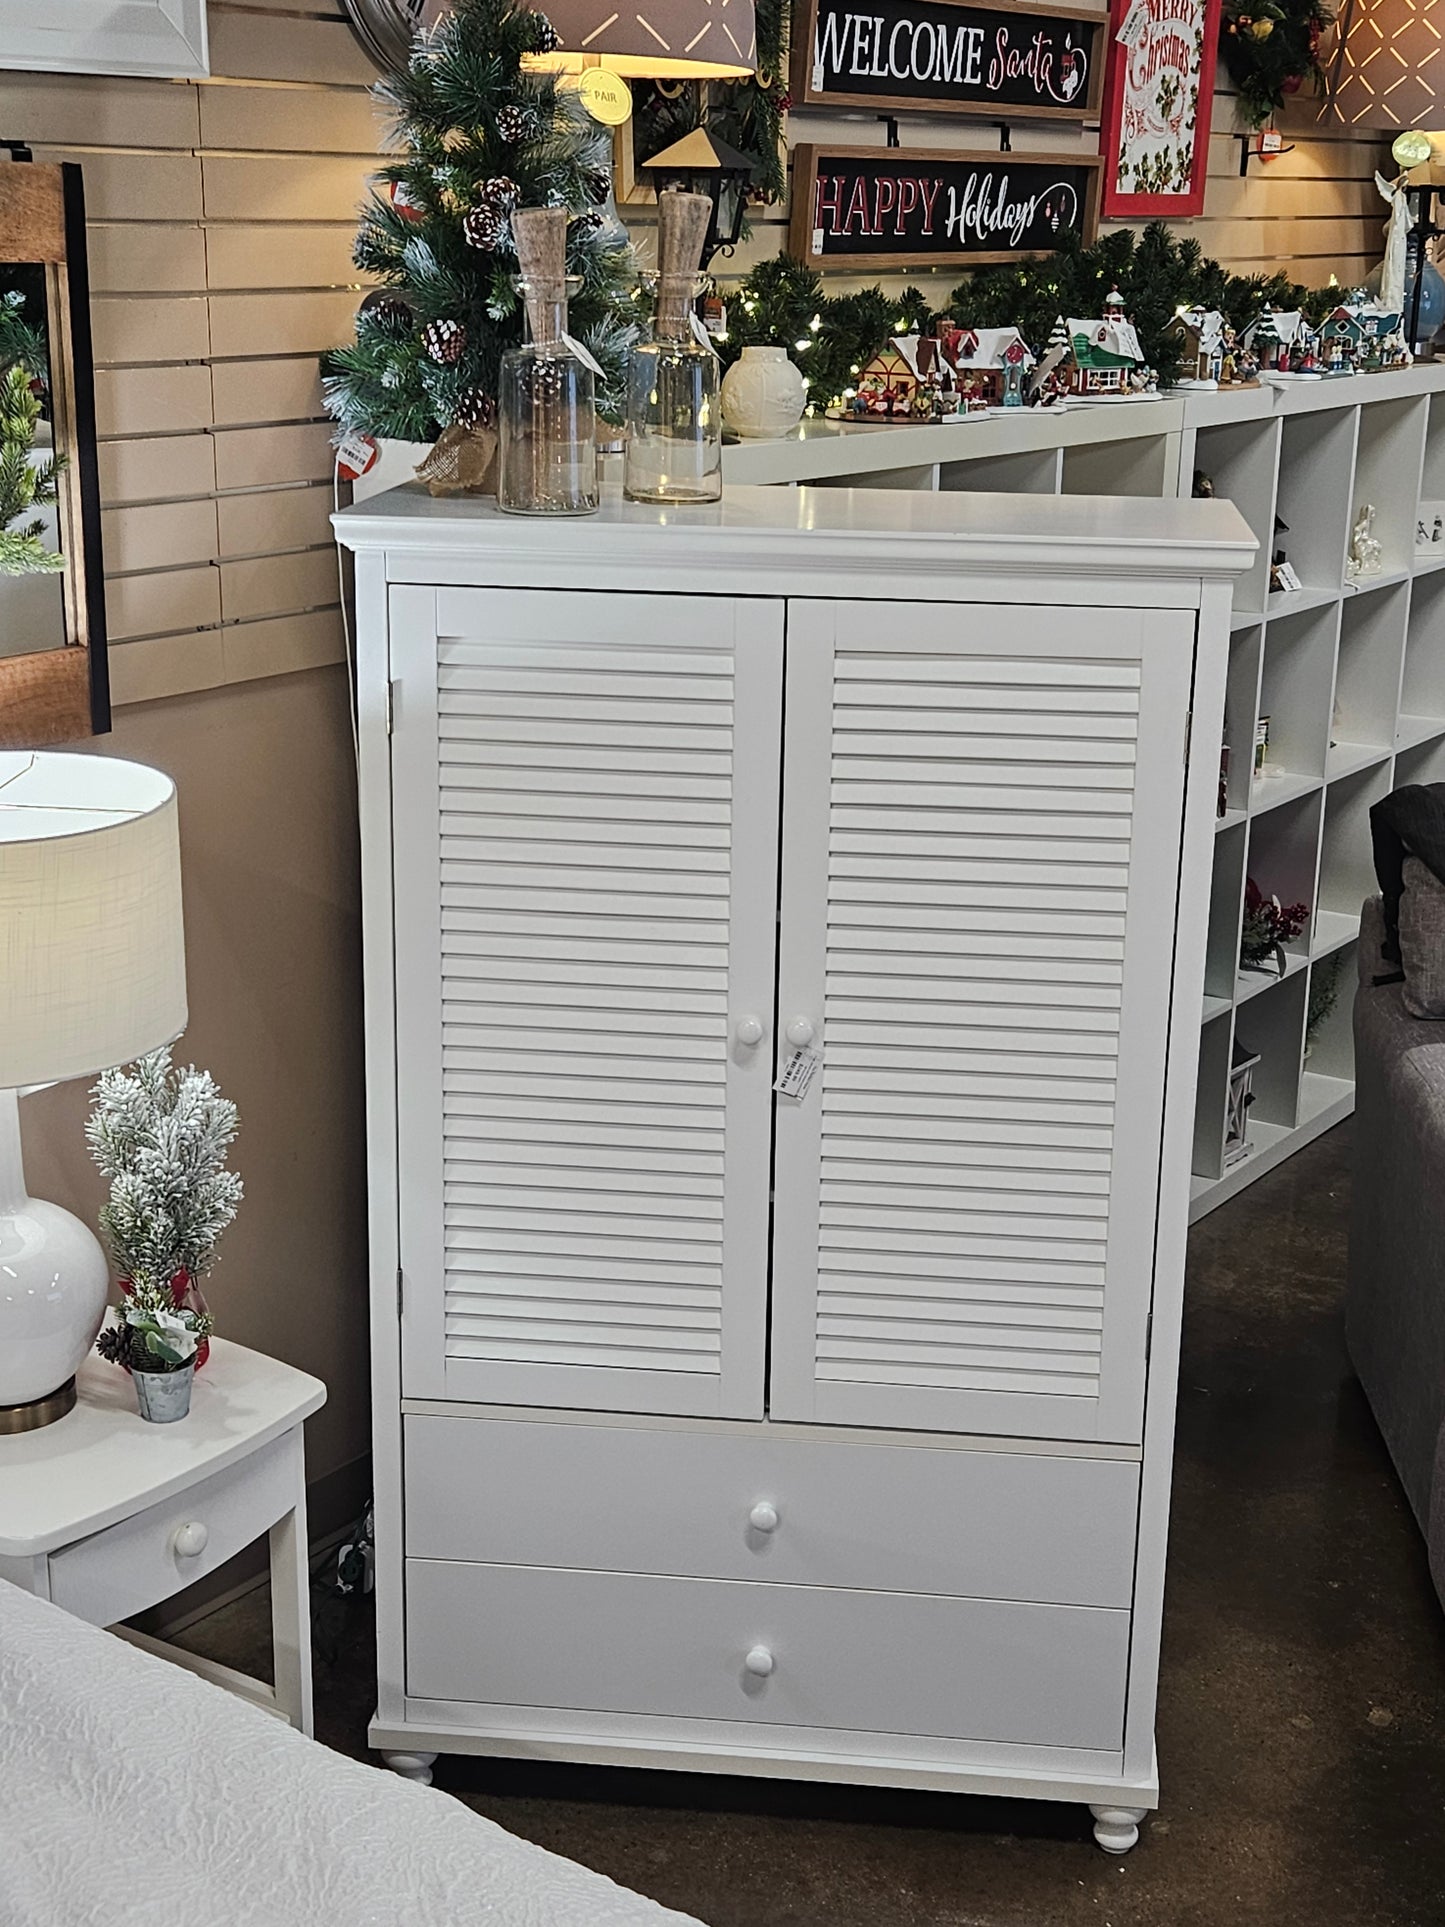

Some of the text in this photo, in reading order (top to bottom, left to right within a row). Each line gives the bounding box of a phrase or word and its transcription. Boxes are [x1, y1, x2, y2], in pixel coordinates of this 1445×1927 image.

[1146, 0, 1198, 27] MERRY
[814, 11, 1087, 103] WELCOME Santa
[1126, 24, 1190, 92] Christmas
[593, 90, 617, 104] PAIR
[815, 172, 1077, 247] HAPPY Holidays
